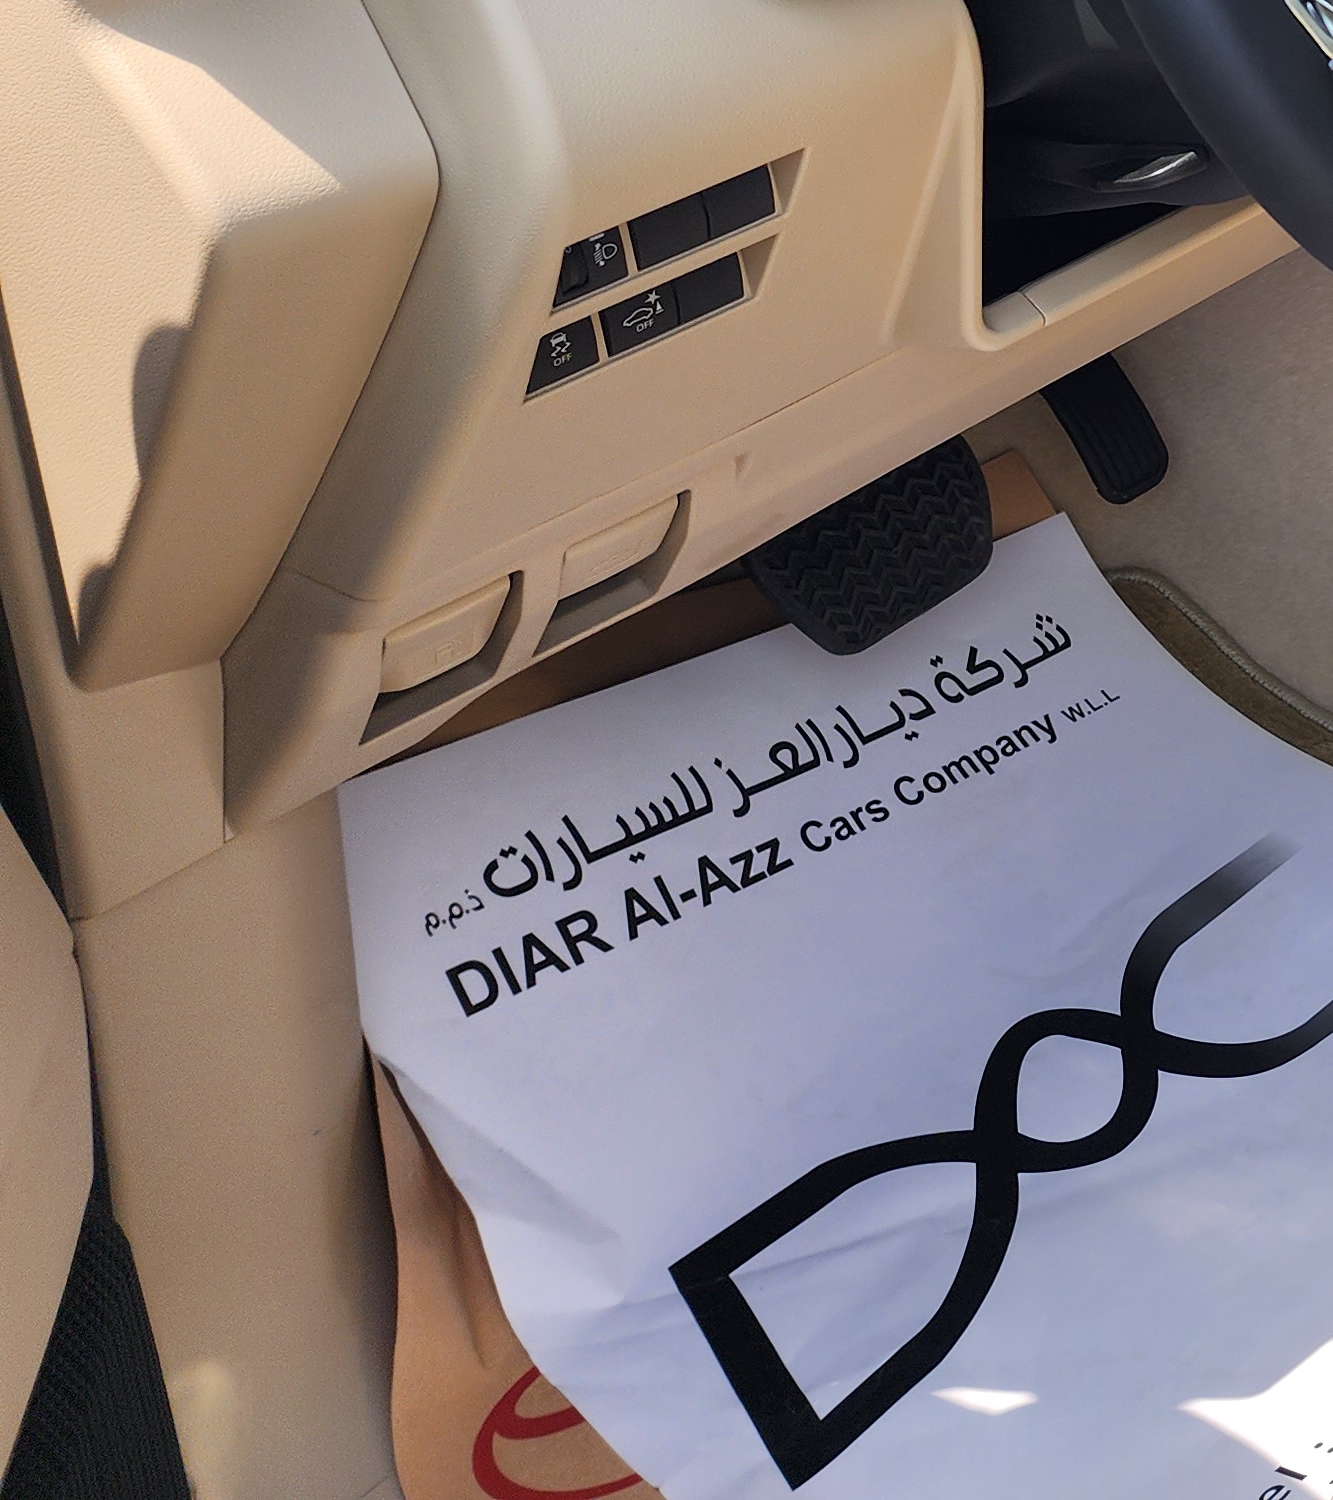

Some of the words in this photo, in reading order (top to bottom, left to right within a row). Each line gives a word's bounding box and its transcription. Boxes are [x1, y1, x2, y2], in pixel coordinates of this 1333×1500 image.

[552, 351, 573, 367] OFF
[635, 317, 656, 333] OFF
[933, 612, 1072, 705] شركة
[712, 717, 836, 819] العز
[832, 687, 937, 770] ديار
[444, 909, 616, 1018] DIAR
[623, 836, 795, 942] Al-Azz
[799, 798, 891, 853] Cars
[893, 712, 1059, 806] Company
[482, 764, 714, 898] للسيارات
